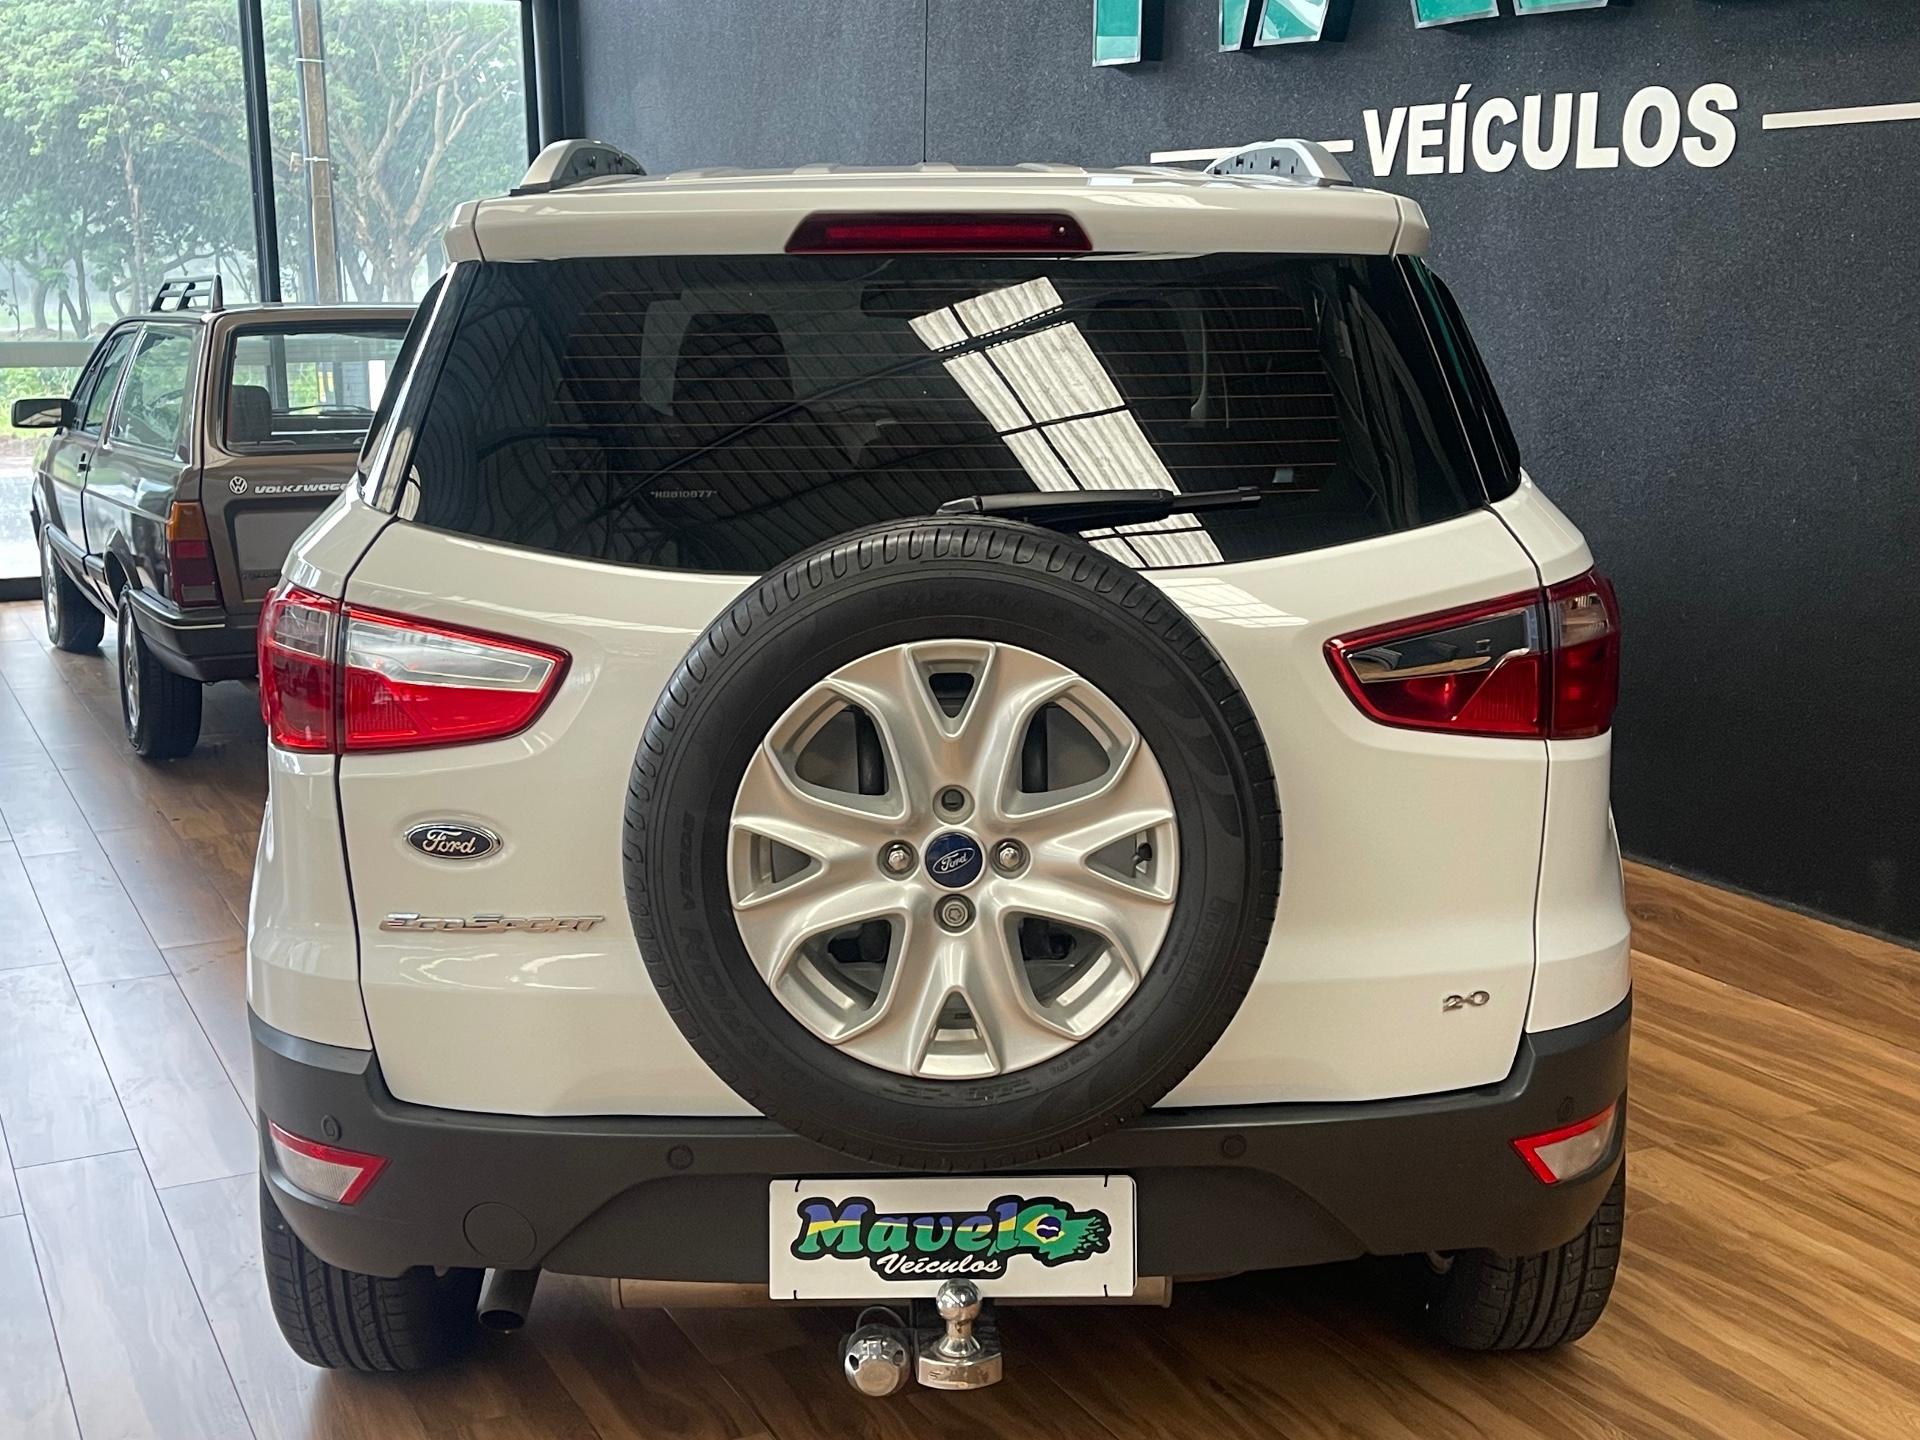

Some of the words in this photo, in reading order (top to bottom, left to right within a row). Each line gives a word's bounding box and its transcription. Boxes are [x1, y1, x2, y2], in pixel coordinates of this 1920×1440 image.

[1363, 83, 1738, 177] VEÍCULOS
[422, 828, 477, 854] Ford
[941, 852, 968, 871] Ford
[876, 1252, 1002, 1275] Veículos
